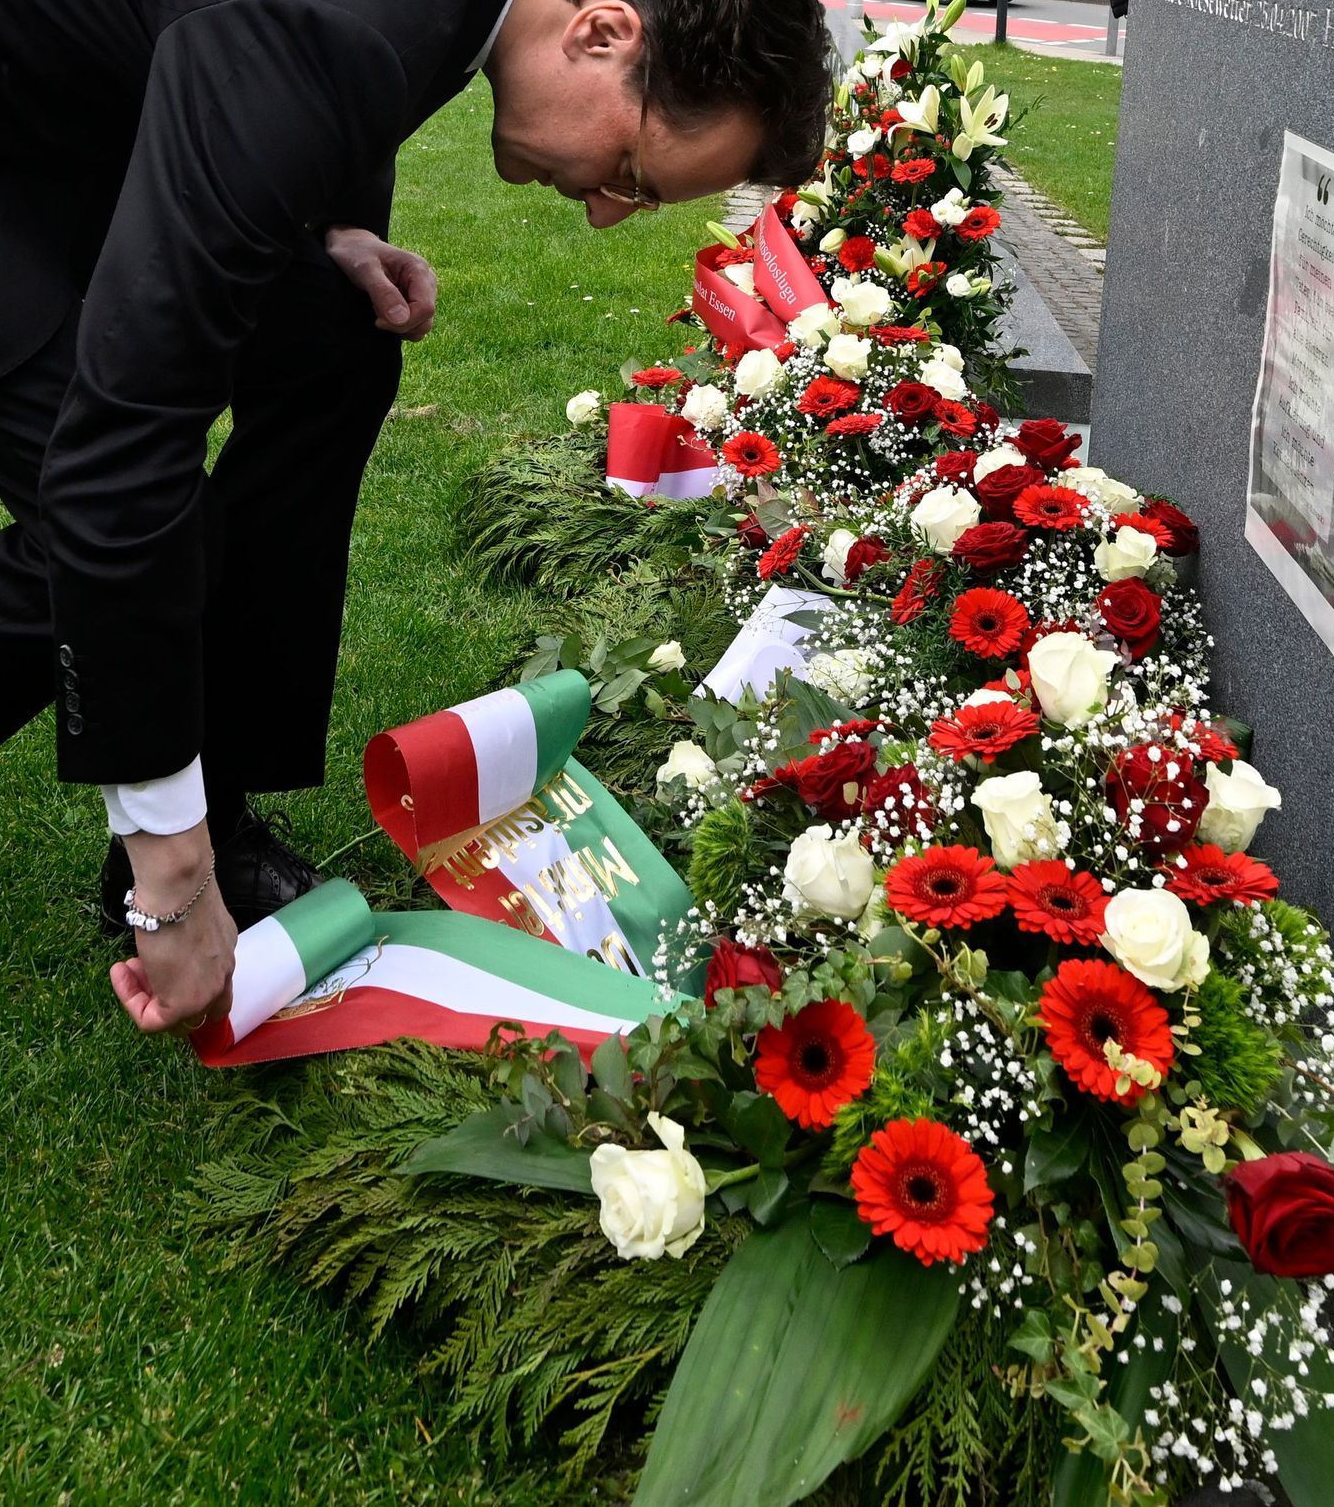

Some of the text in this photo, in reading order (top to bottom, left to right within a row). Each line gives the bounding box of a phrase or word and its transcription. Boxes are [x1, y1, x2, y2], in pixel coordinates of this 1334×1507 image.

[1305, 205, 1314, 221] Ich
[1299, 254, 1331, 289] für meinen
[708, 290, 736, 322] Essen
[1278, 395, 1325, 449] Aufklärung und
[1291, 436, 1315, 467] möchte
